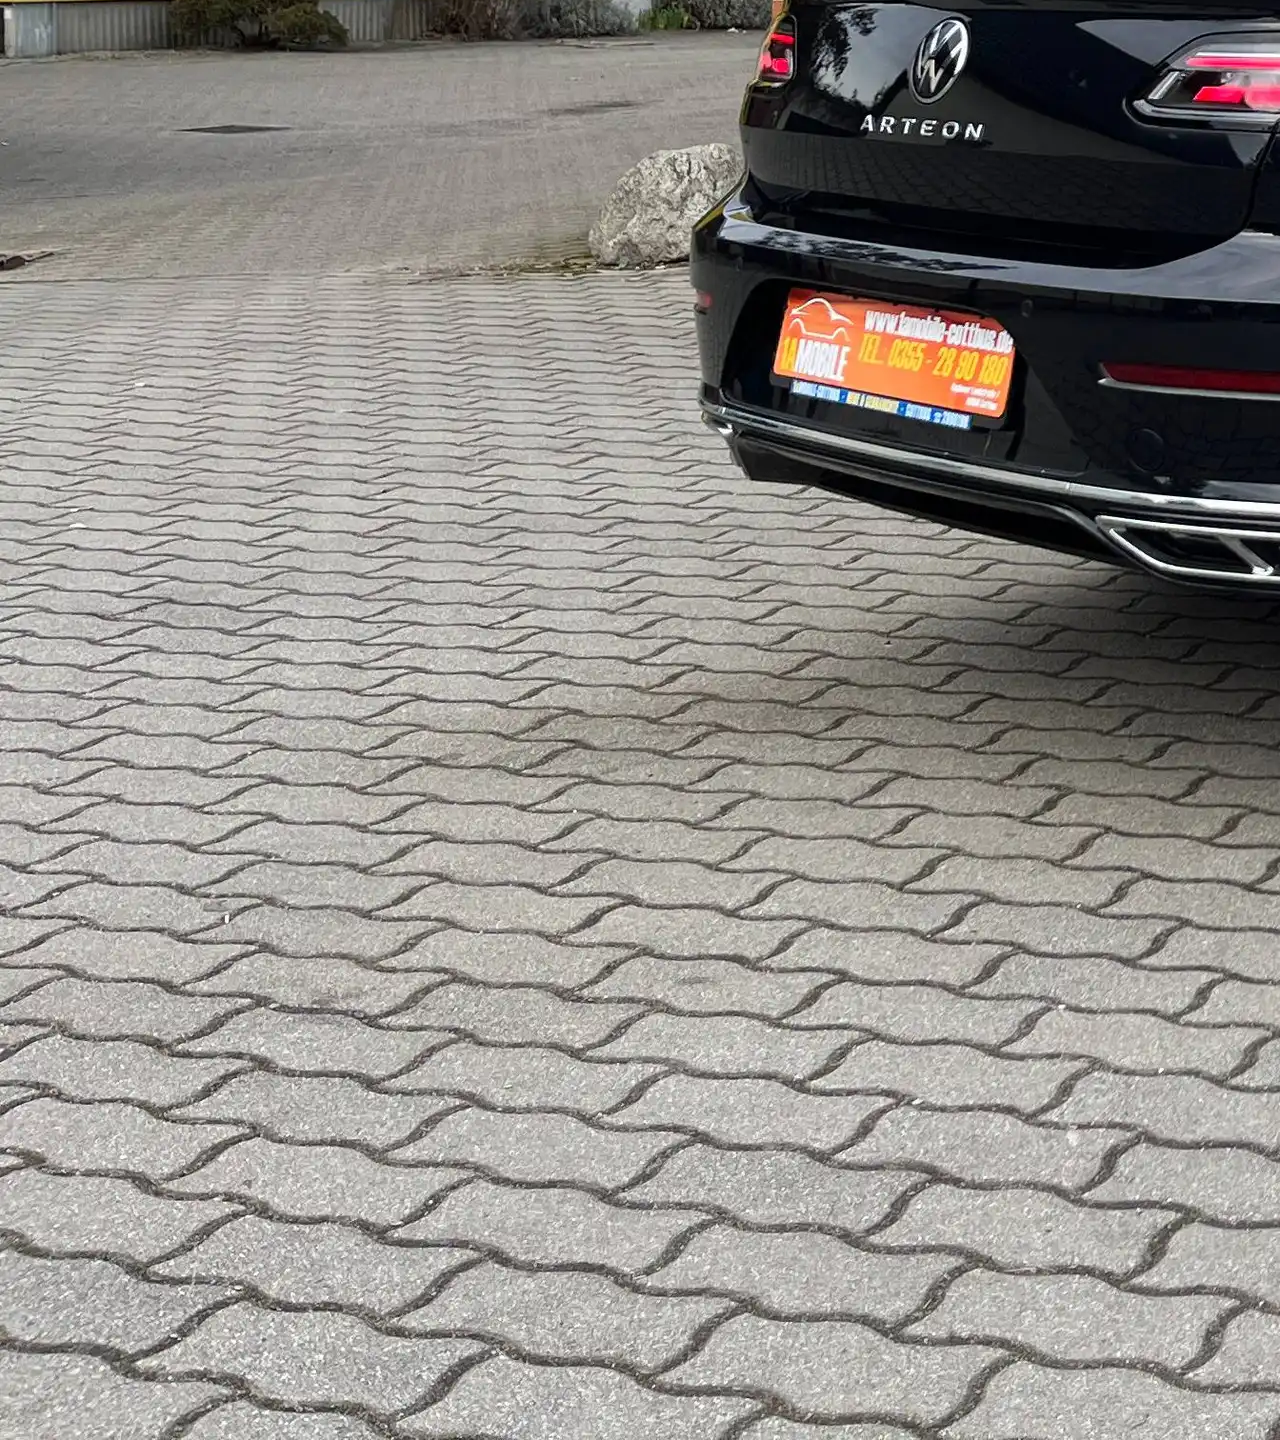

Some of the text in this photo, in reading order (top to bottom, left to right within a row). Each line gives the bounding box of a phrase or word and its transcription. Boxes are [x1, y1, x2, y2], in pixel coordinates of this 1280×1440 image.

[860, 113, 984, 142] ARTEON
[888, 338, 928, 372] 0355
[932, 346, 958, 378] 28
[954, 350, 980, 382] 90
[978, 353, 1010, 386] 180
